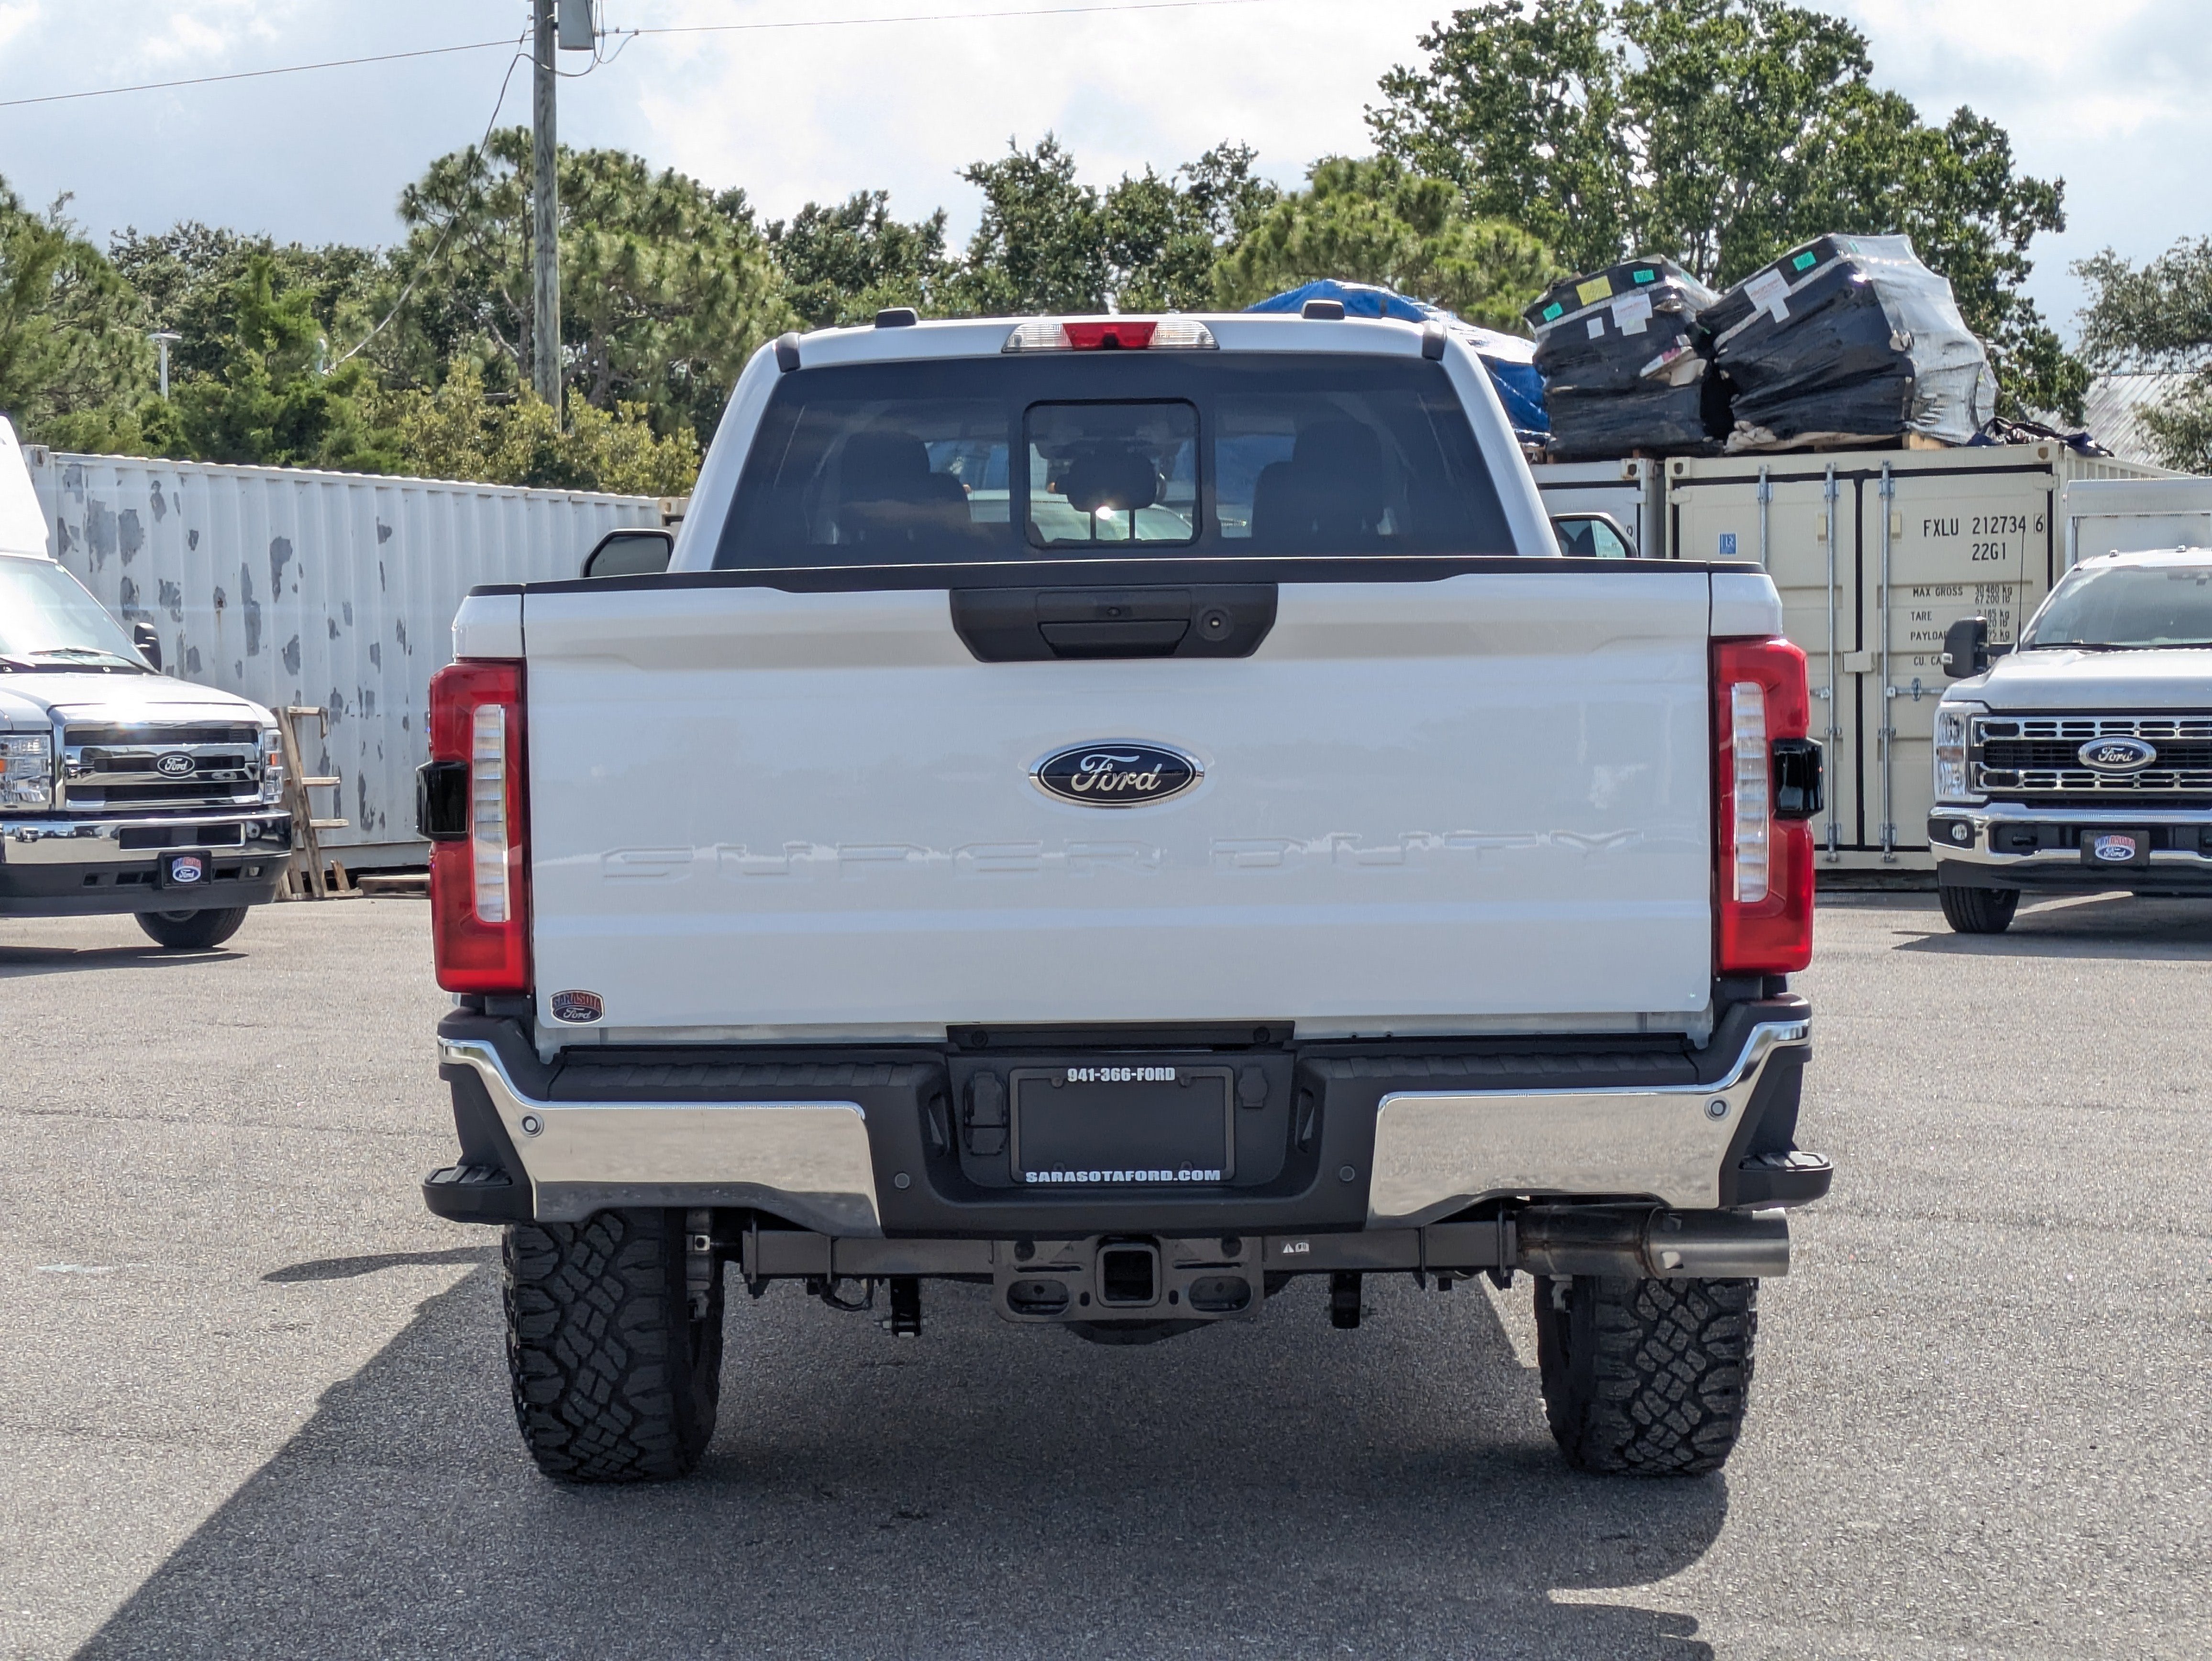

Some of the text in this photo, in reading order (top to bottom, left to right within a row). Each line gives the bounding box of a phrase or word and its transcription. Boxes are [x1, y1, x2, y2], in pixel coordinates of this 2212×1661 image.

[1924, 514, 2044, 537] FXLU 212734 6
[1972, 543, 2006, 561] 22G1
[1913, 587, 1931, 598] MAX
[1935, 586, 1963, 597] GROSS
[1911, 611, 1932, 621] TARE
[2000, 609, 2010, 620] kg
[1911, 631, 1946, 641] PAYLOA
[2000, 629, 2010, 642] kg
[2098, 746, 2134, 762] Ford
[165, 757, 188, 771] Ford
[1071, 754, 1162, 792] Ford
[2103, 847, 2126, 857] Ford
[178, 869, 195, 878] Ford
[564, 1007, 592, 1019] Ford
[1067, 1067, 1176, 1082] 941-366-FORD
[1026, 1170, 1221, 1187] SARASOTAFORD.COM
